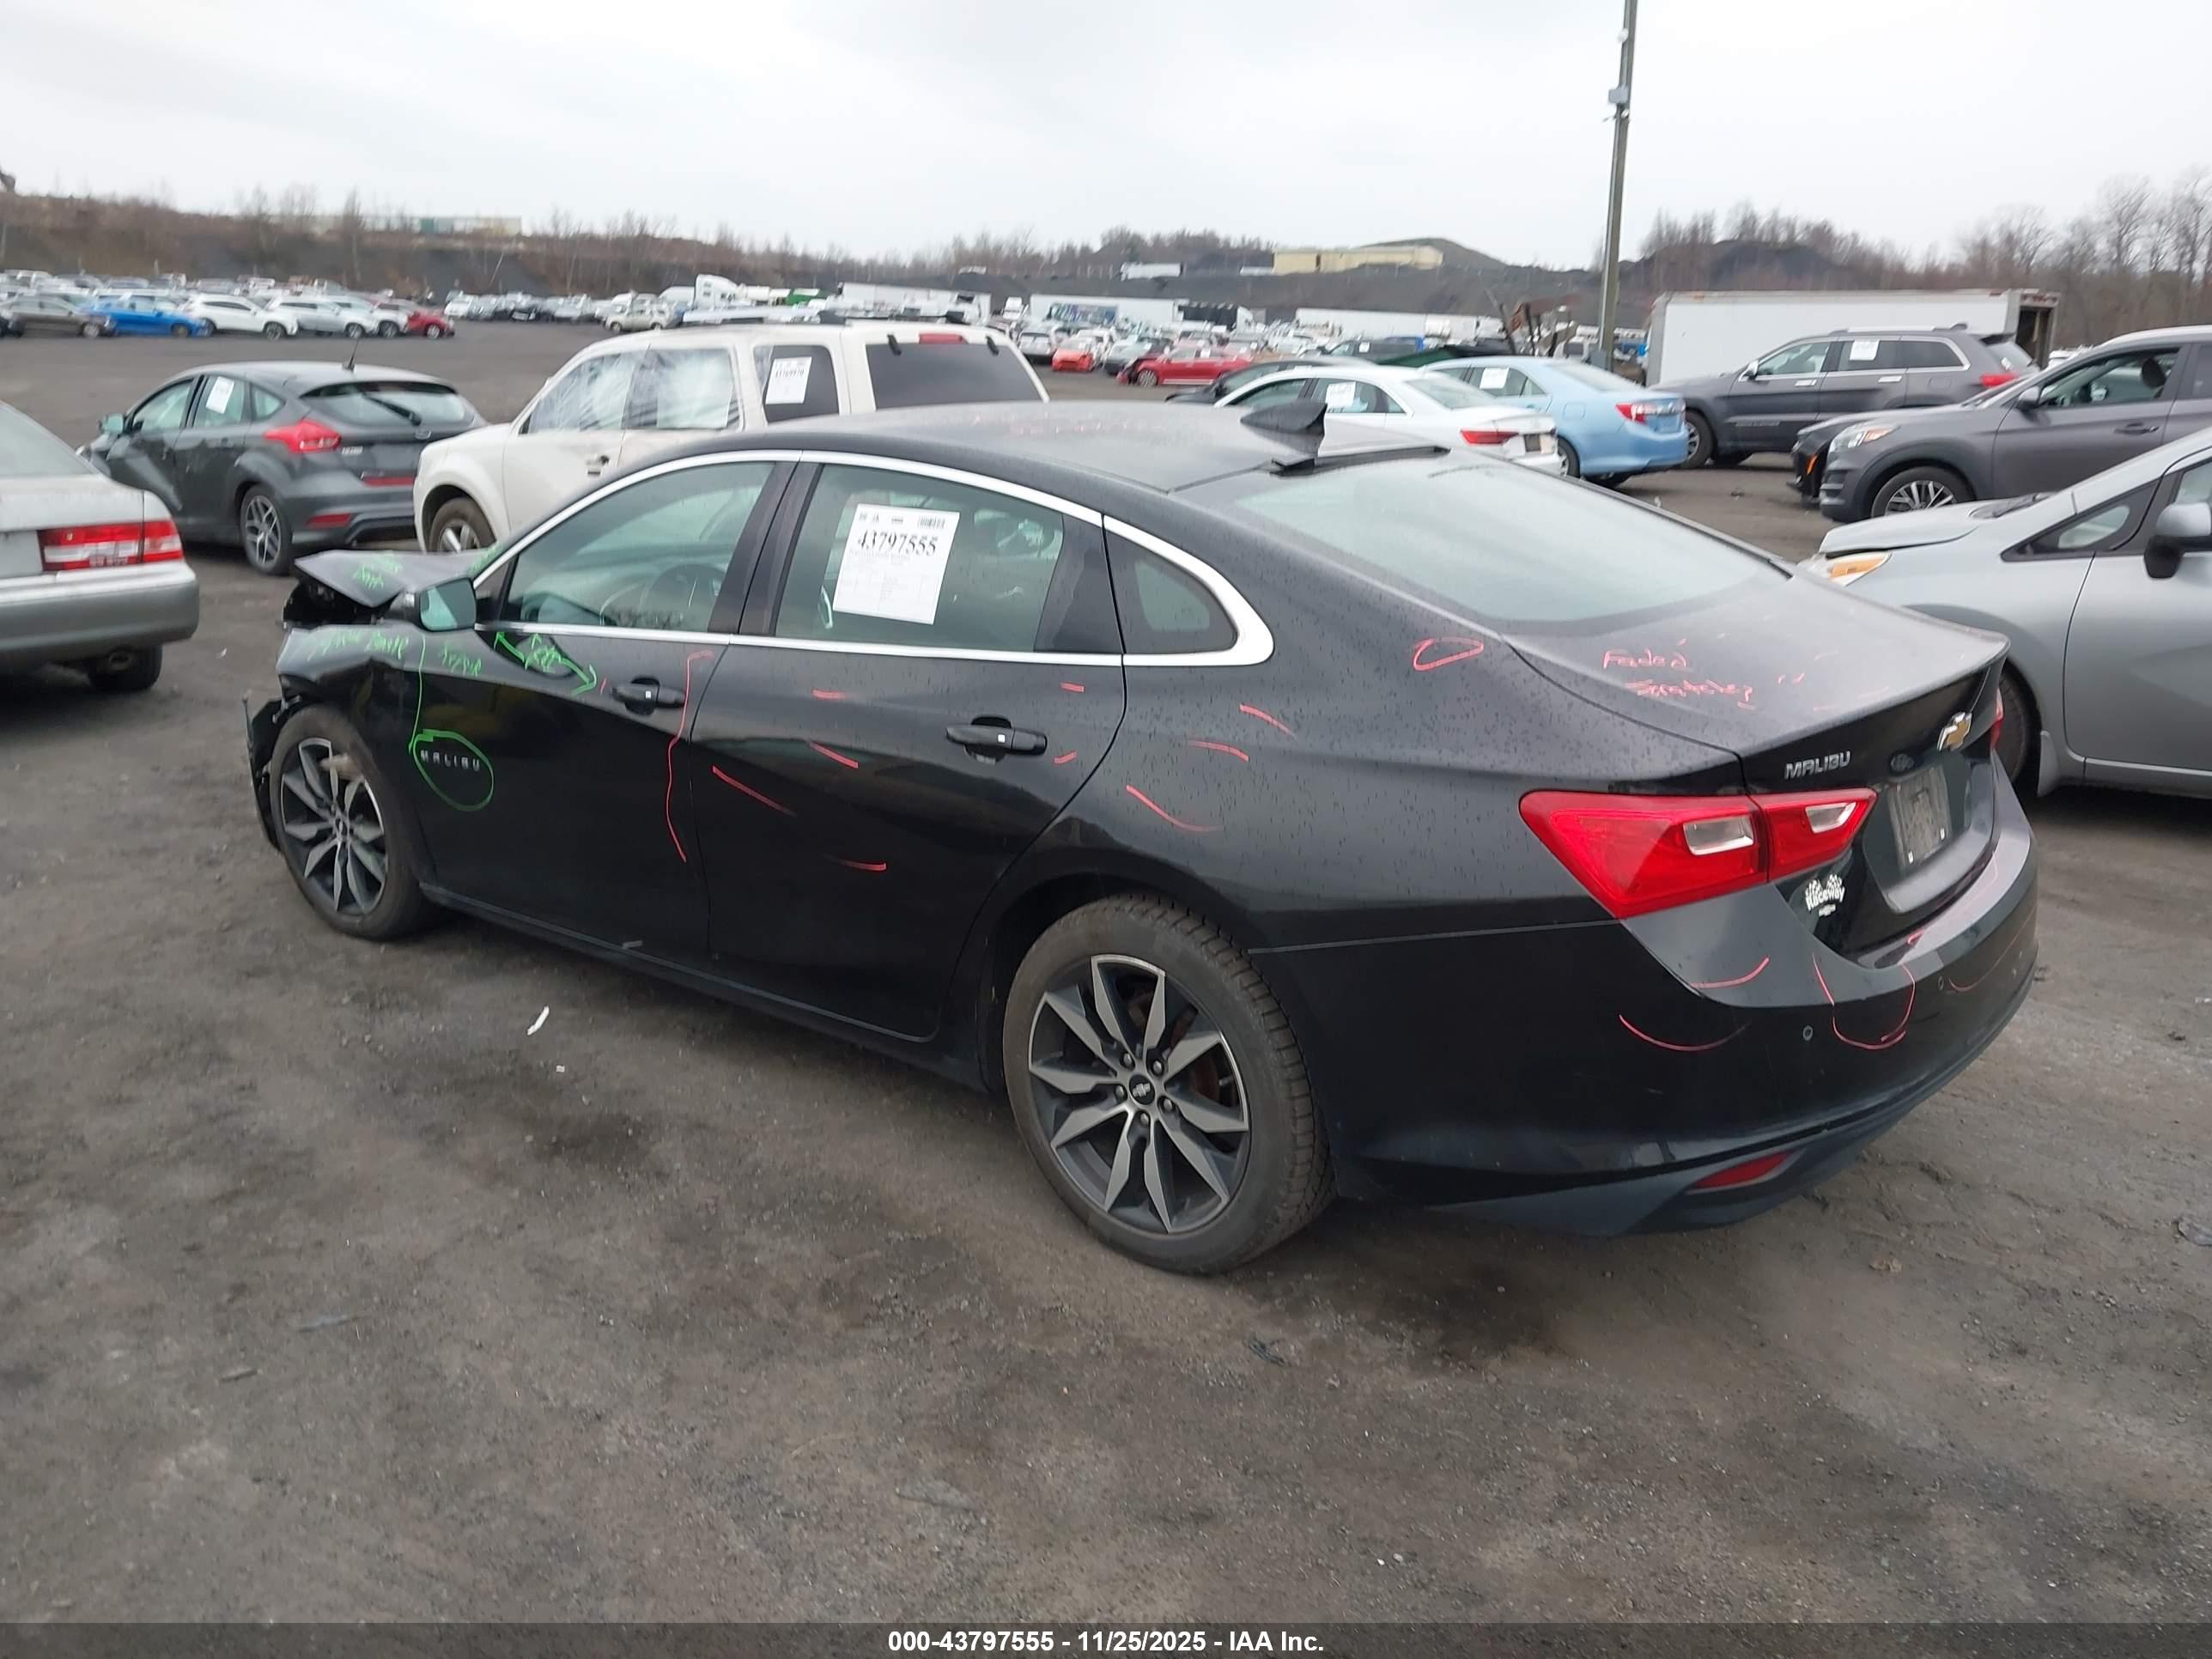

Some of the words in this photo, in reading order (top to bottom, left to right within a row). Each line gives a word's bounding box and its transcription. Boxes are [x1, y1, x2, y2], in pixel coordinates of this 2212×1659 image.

[858, 529, 939, 556] 43797555
[420, 750, 480, 772] MALIBU
[1784, 750, 1850, 780] MALIBU
[1805, 886, 1845, 911] Raceway
